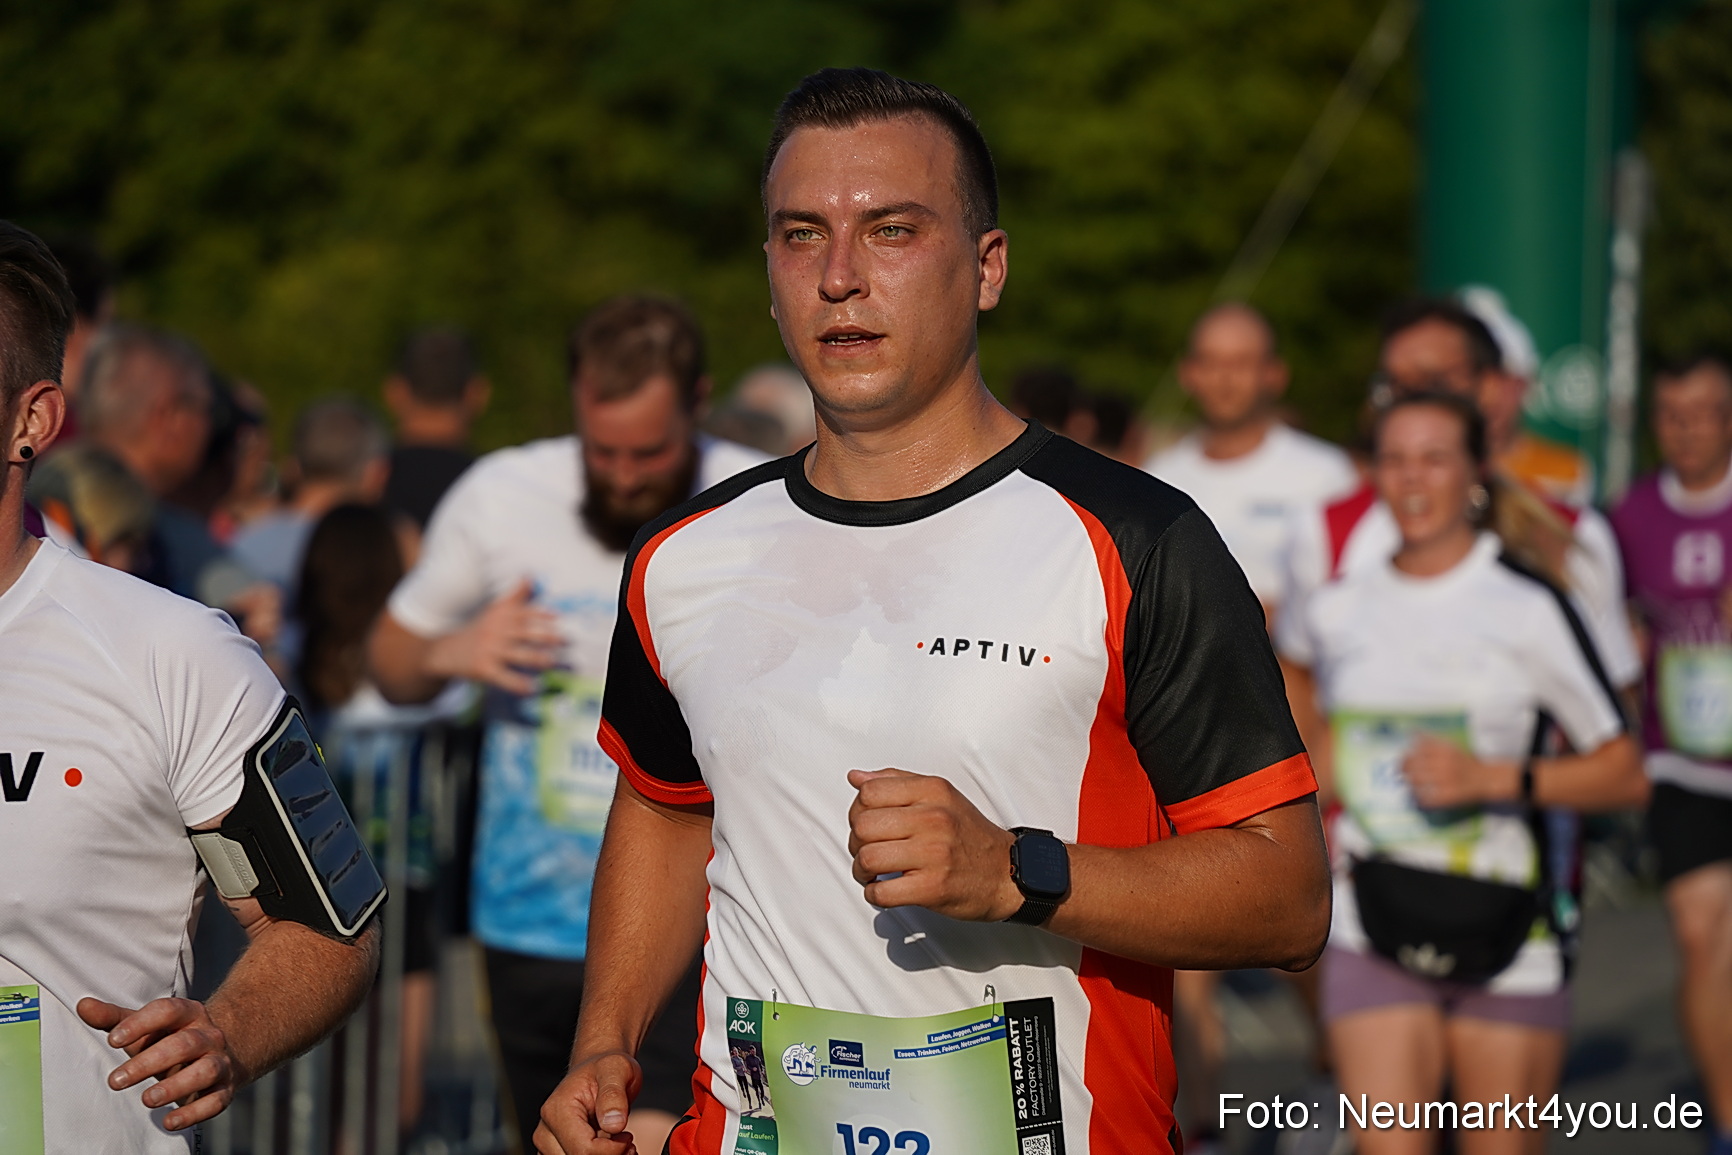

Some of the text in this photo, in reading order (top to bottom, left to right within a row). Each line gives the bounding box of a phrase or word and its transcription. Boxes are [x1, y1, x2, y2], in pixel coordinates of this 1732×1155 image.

[929, 637, 1037, 667] APTIV
[728, 1020, 757, 1035] AOK
[820, 1065, 891, 1081] Firmenlauf
[1009, 1018, 1028, 1120] 20 % RABATT
[1023, 1017, 1040, 1117] FACTORY OUTLET
[848, 1080, 891, 1090] neumarkt
[738, 1131, 750, 1139] auf
[836, 1123, 931, 1155] 122
